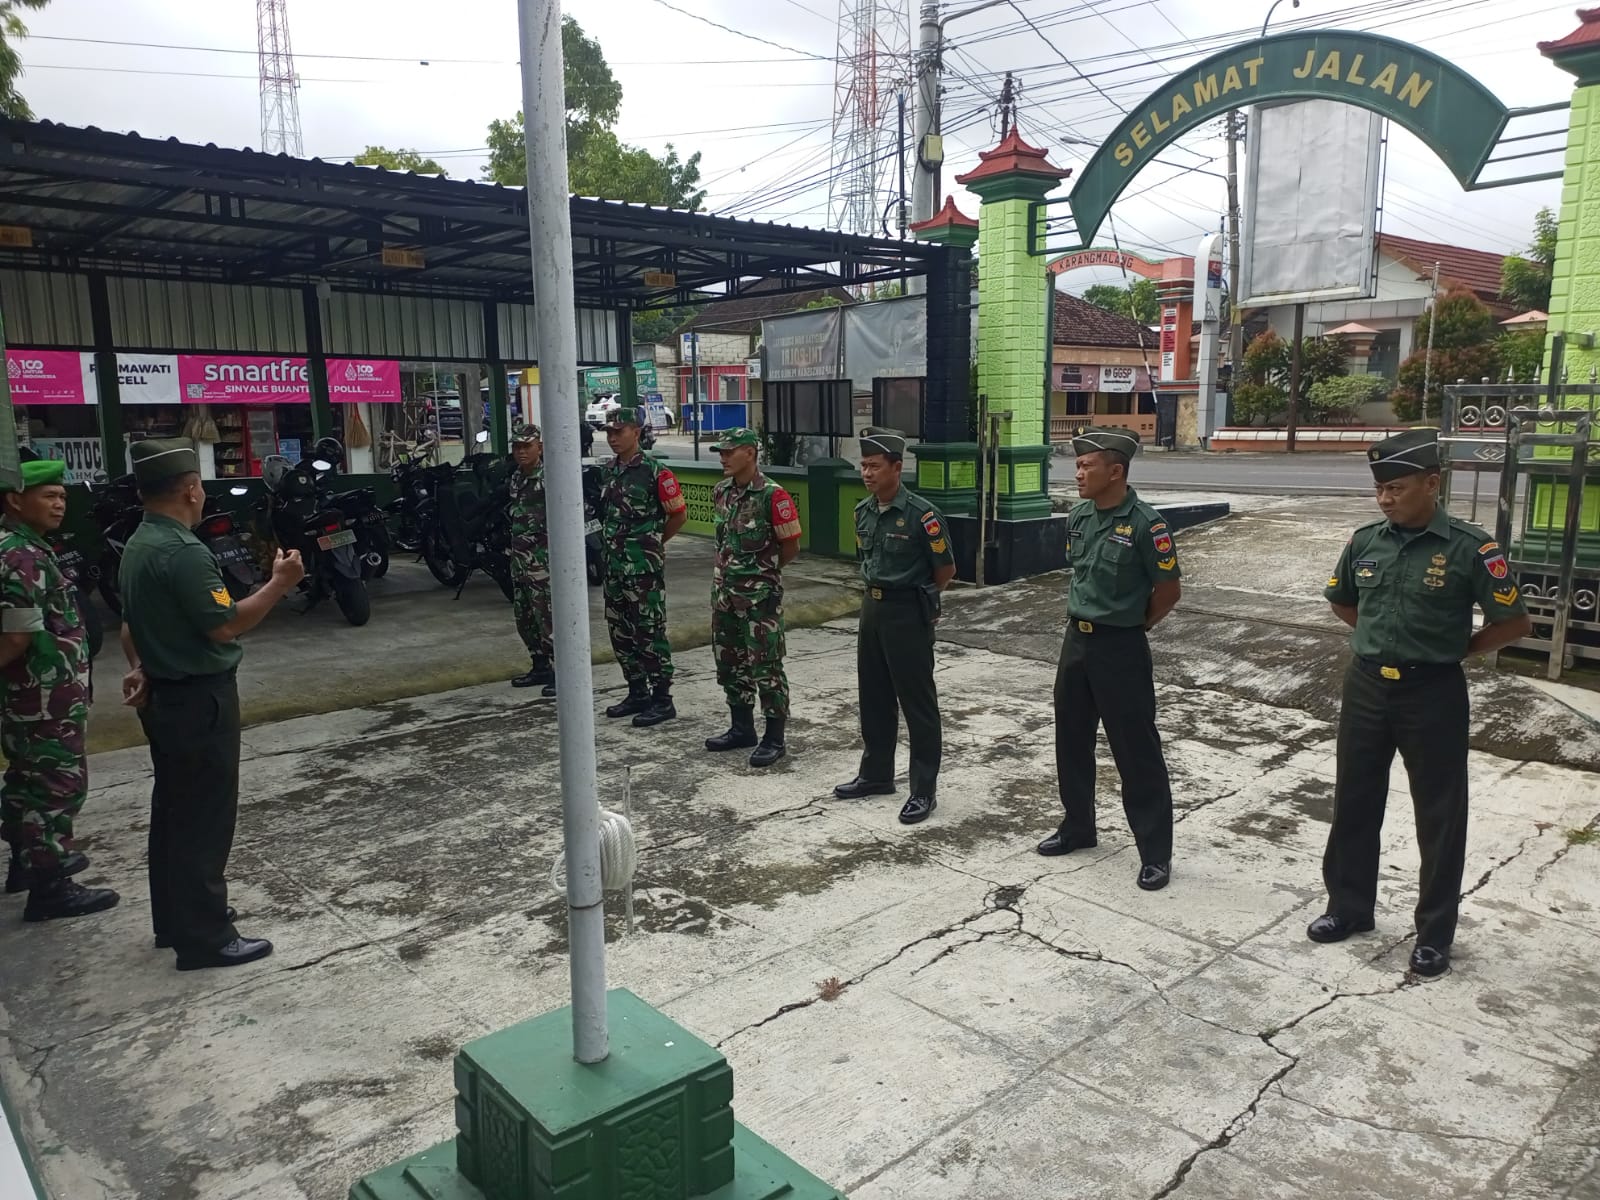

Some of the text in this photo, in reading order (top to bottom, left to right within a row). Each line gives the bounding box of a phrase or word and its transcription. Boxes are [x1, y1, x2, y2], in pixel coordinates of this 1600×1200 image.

[1114, 50, 1434, 168] SELAMAT JALAN
[1059, 252, 1134, 270] KARANGMALANG
[1113, 367, 1132, 379] GGSP
[117, 375, 148, 385] CELL
[225, 384, 269, 394] SINYALE
